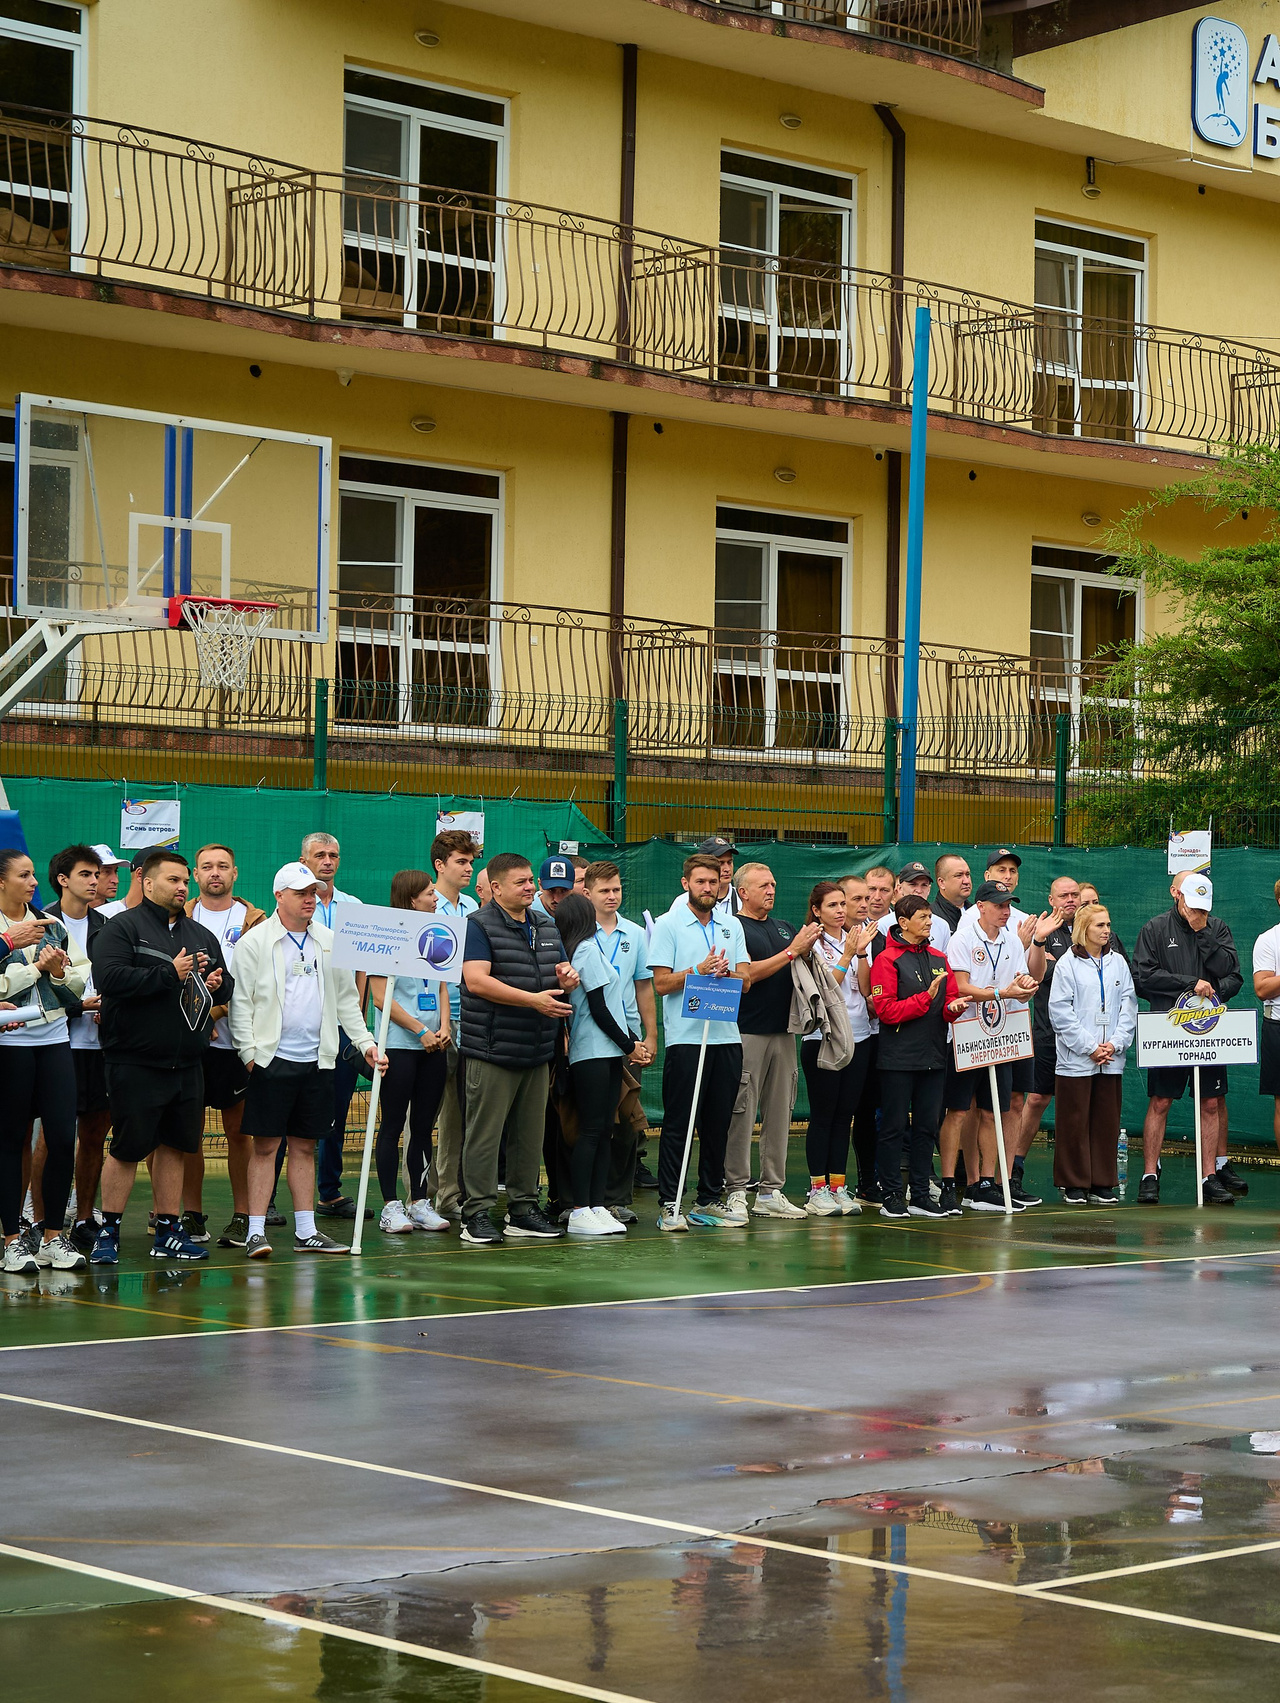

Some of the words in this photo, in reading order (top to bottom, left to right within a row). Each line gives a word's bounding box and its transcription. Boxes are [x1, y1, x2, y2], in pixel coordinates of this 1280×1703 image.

[344, 921, 369, 930] Филиал
[957, 1031, 1030, 1054] ЛАБИНСКЭЛЕКТРОСЕТЬ
[1142, 1037, 1253, 1050] КУРГАНИНСКЭЛЕКТРОСЕТЬ
[970, 1045, 1020, 1064] ЭНЕРГОРАЗРЯД
[1178, 1051, 1217, 1062] ТОРНАДО
